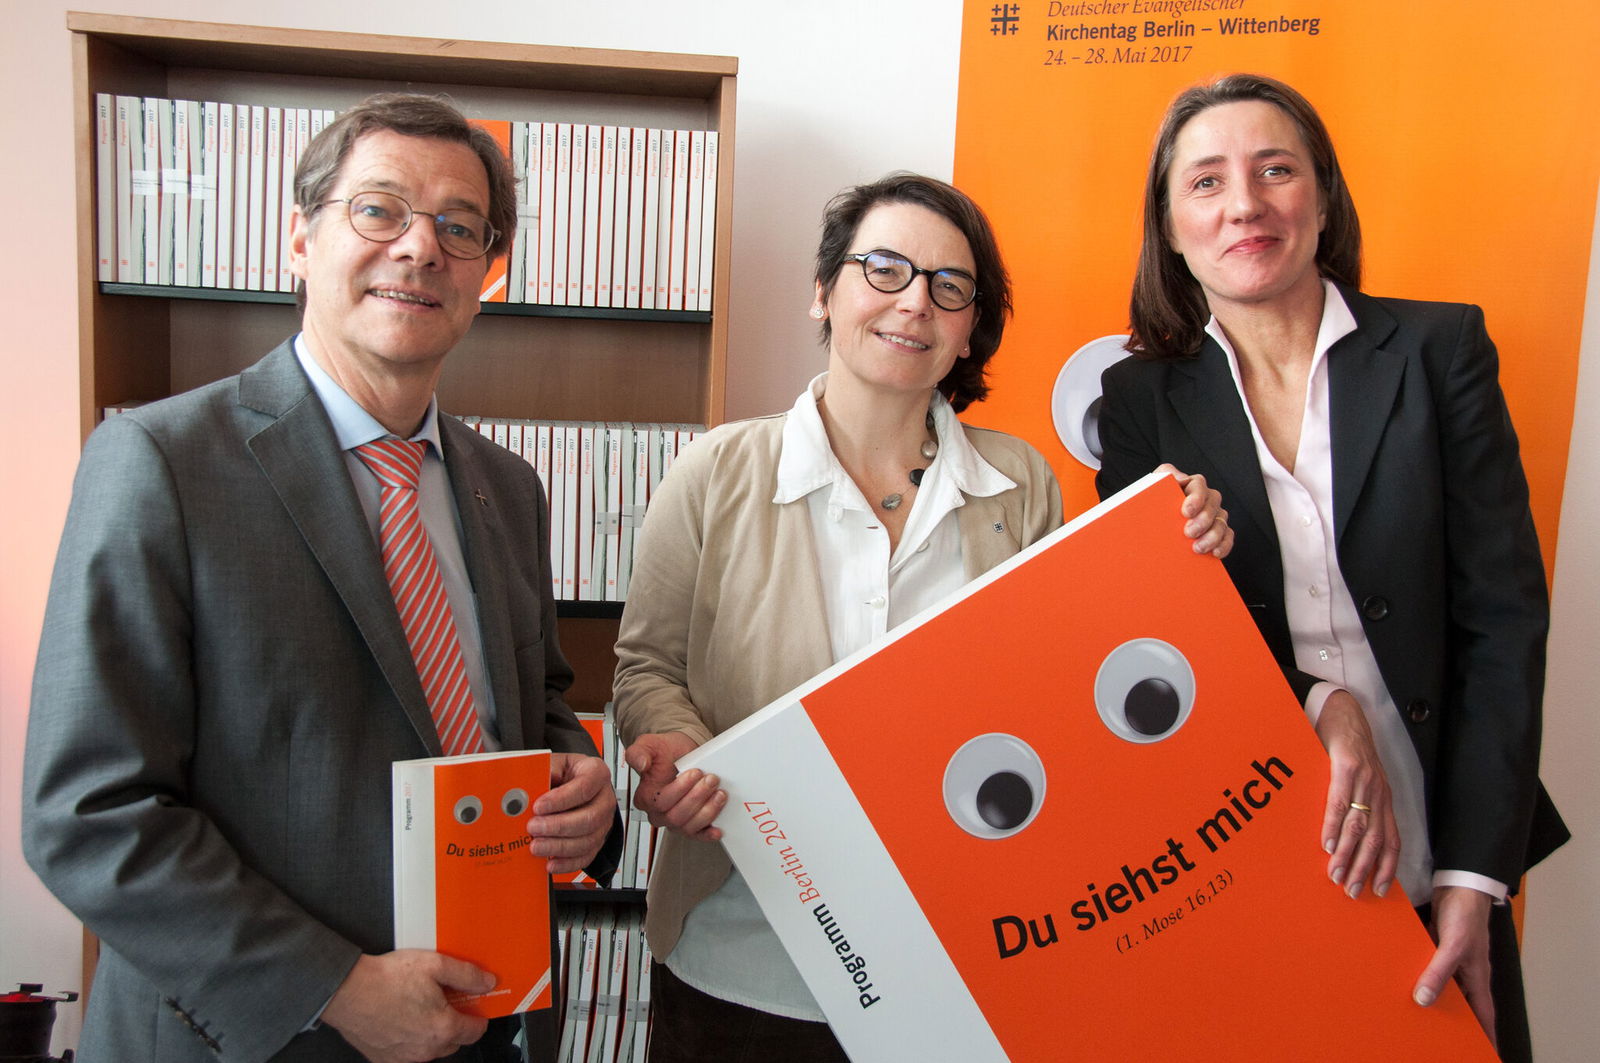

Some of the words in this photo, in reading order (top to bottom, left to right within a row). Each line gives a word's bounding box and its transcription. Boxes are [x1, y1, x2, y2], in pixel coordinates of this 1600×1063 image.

[1047, 24, 1137, 42] Kirchentag
[1143, 20, 1195, 38] Berlin
[1218, 15, 1320, 36] Wittenberg
[1048, 0, 1130, 18] Deutscher
[1044, 49, 1067, 66] 24.
[1084, 48, 1108, 64] 28.
[1112, 46, 1146, 64] Mai
[1150, 46, 1192, 63] 2017
[446, 843, 464, 857] Du
[469, 842, 505, 857] siehst
[508, 835, 534, 851] mic
[744, 800, 787, 846] 2017
[779, 844, 821, 904] Berlin
[992, 913, 1059, 960] Du
[1070, 838, 1196, 932] siehst
[1196, 756, 1294, 853] mich
[1115, 933, 1139, 955] (1.
[1142, 906, 1184, 940] Mose
[1184, 869, 1234, 910] 16,13)
[812, 902, 881, 1010] Programm
